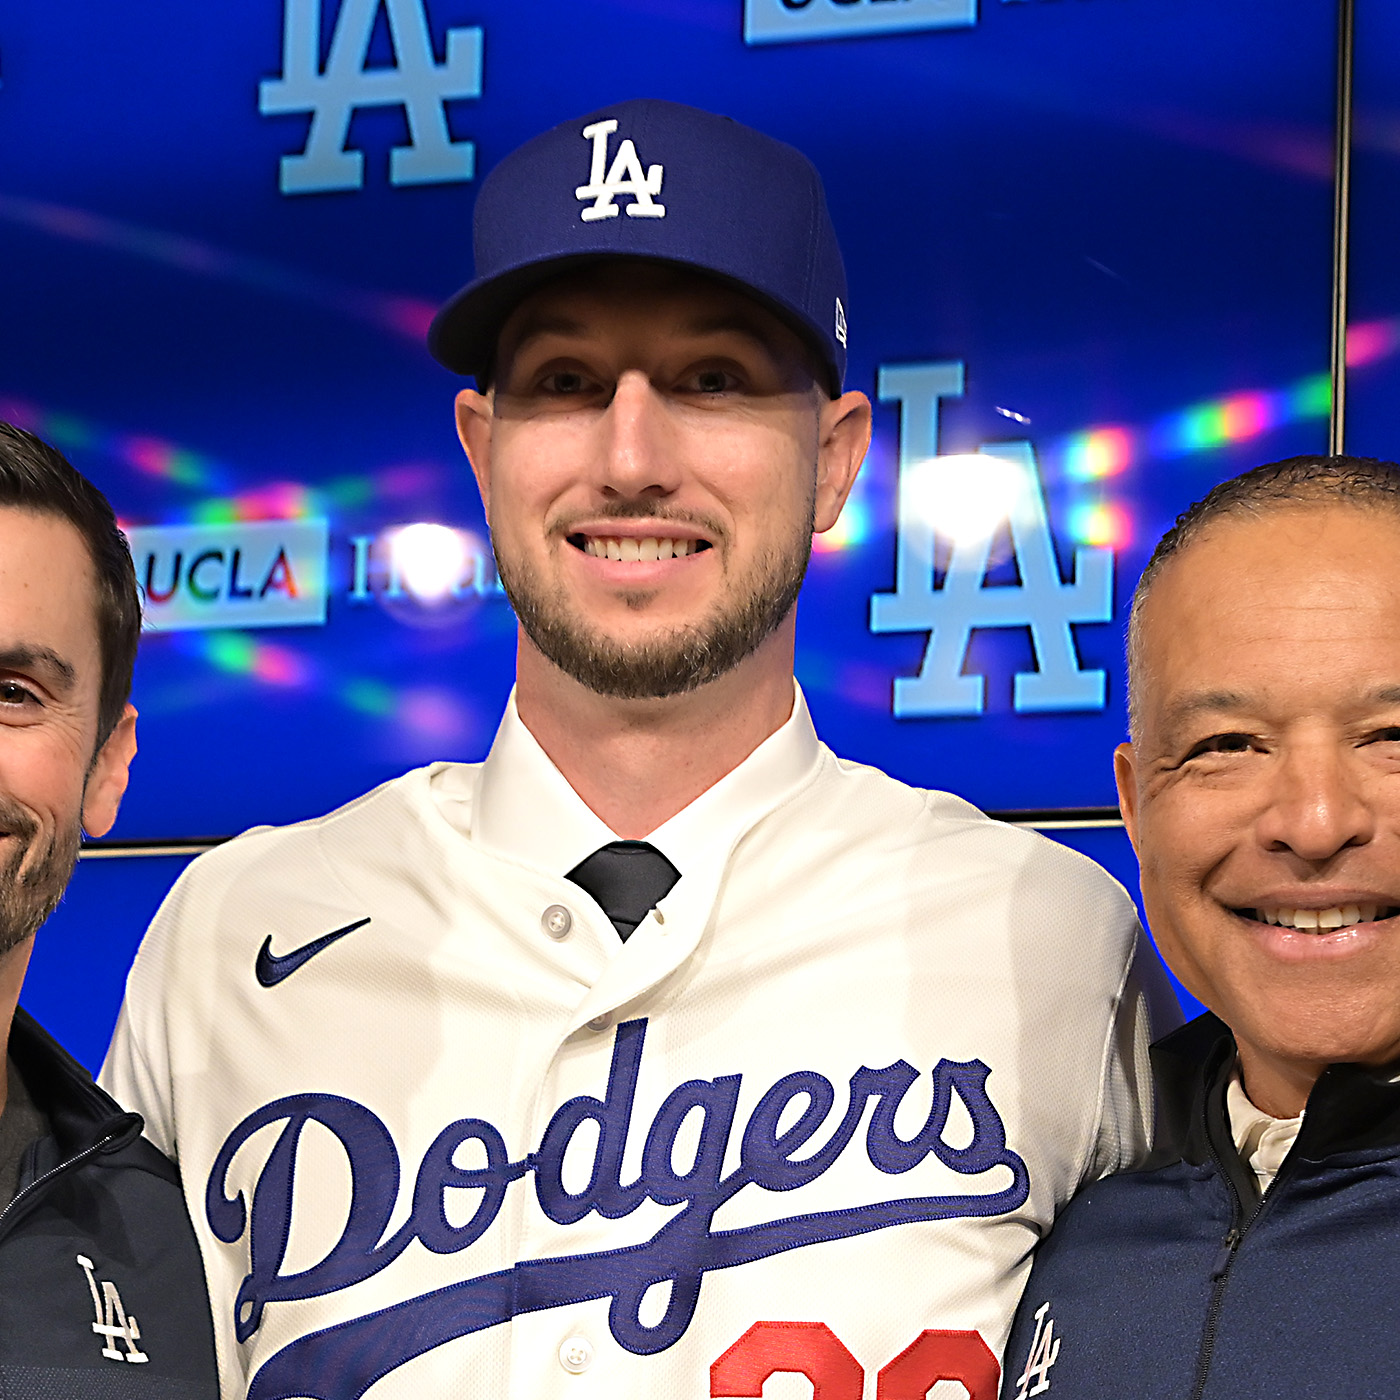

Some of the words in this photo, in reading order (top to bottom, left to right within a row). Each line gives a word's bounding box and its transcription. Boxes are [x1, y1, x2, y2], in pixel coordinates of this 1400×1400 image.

[575, 119, 666, 222] LA
[145, 546, 298, 602] UCLA
[871, 360, 1113, 718] LA
[76, 1254, 150, 1363] LA
